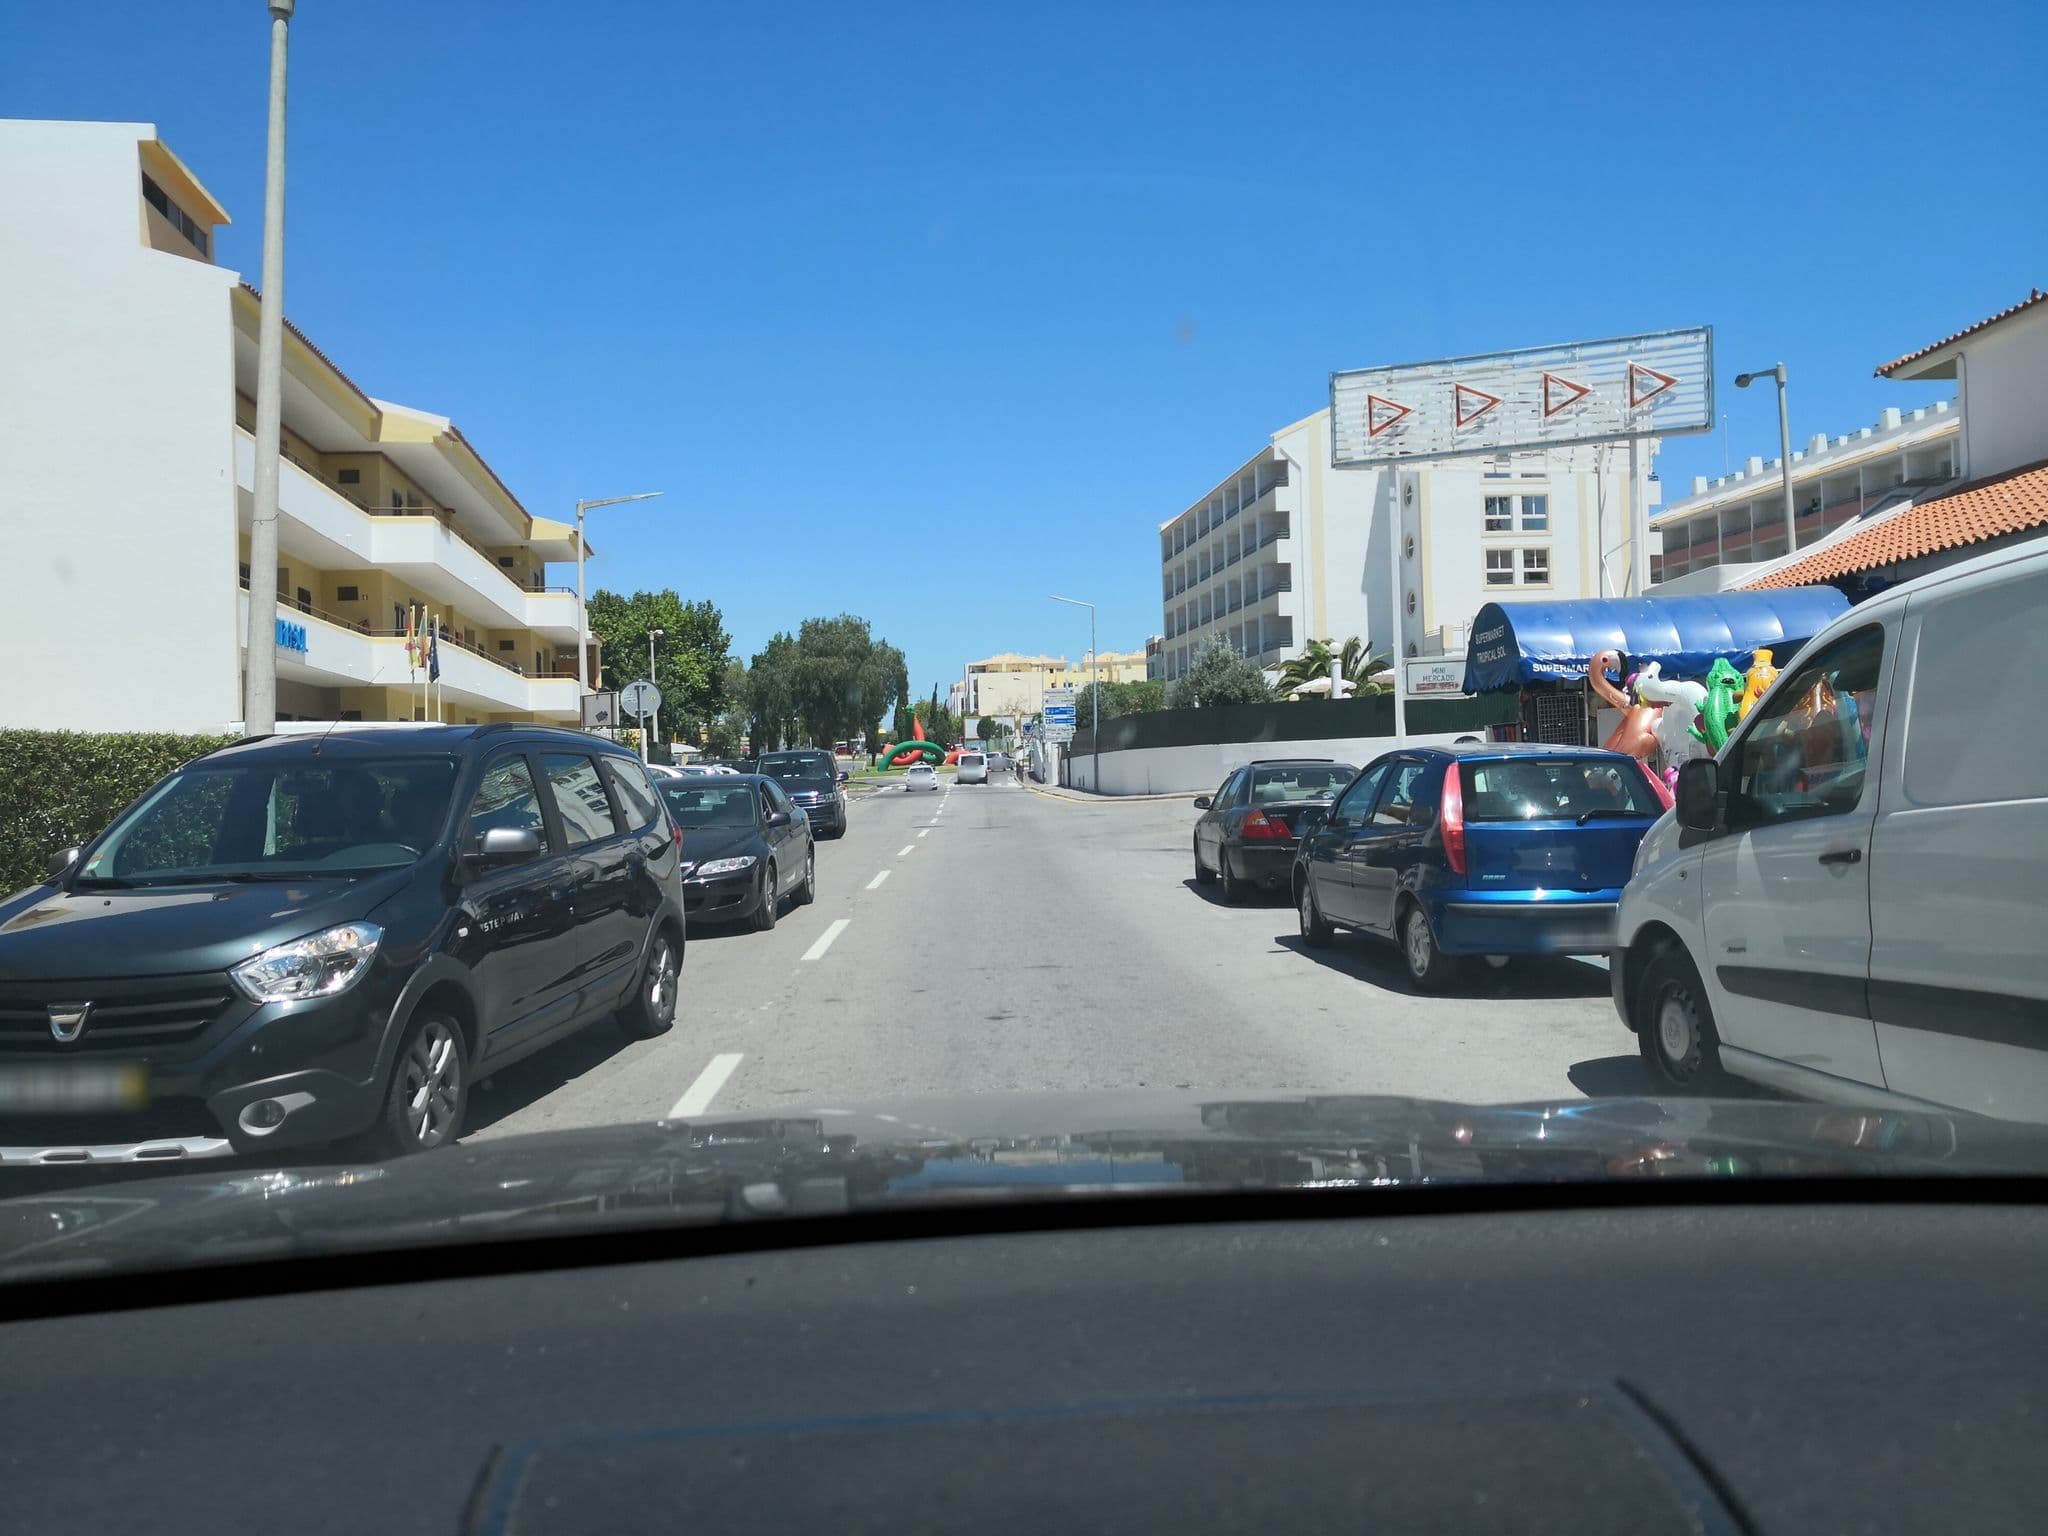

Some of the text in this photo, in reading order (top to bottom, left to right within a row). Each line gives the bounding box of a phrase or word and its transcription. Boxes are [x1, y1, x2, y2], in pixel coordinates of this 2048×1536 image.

[1475, 625, 1505, 645] SUPERMARKET
[1431, 666, 1446, 674] MINI
[1532, 663, 1590, 673] SUPERMAR
[1422, 674, 1455, 682] MERCADO
